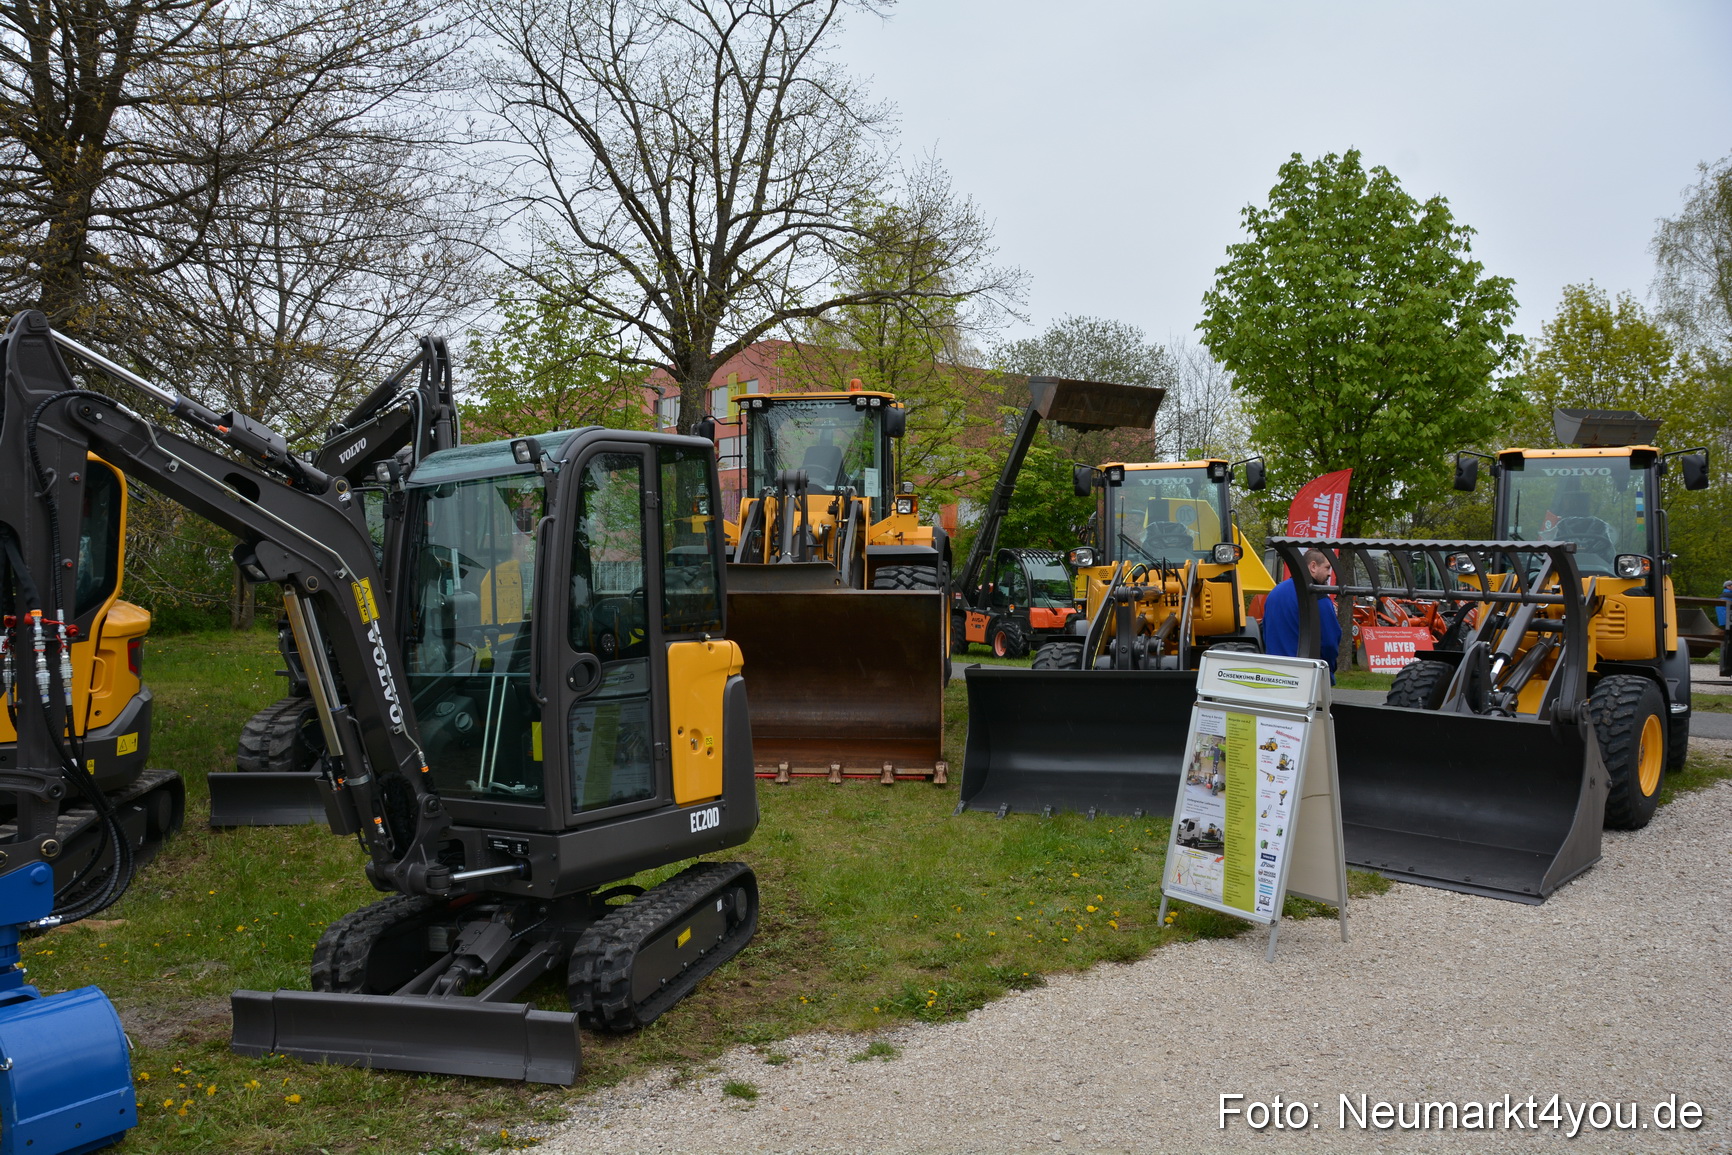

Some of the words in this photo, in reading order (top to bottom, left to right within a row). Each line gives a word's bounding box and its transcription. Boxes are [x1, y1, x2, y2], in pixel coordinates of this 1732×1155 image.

[786, 401, 836, 409] VOLVO
[339, 437, 367, 464] VOLVO
[1542, 467, 1611, 476] VOLVO
[1139, 477, 1194, 486] VOLVO
[1384, 641, 1416, 652] MEYER
[367, 620, 404, 724] VOLVO
[690, 806, 720, 833] EC20D
